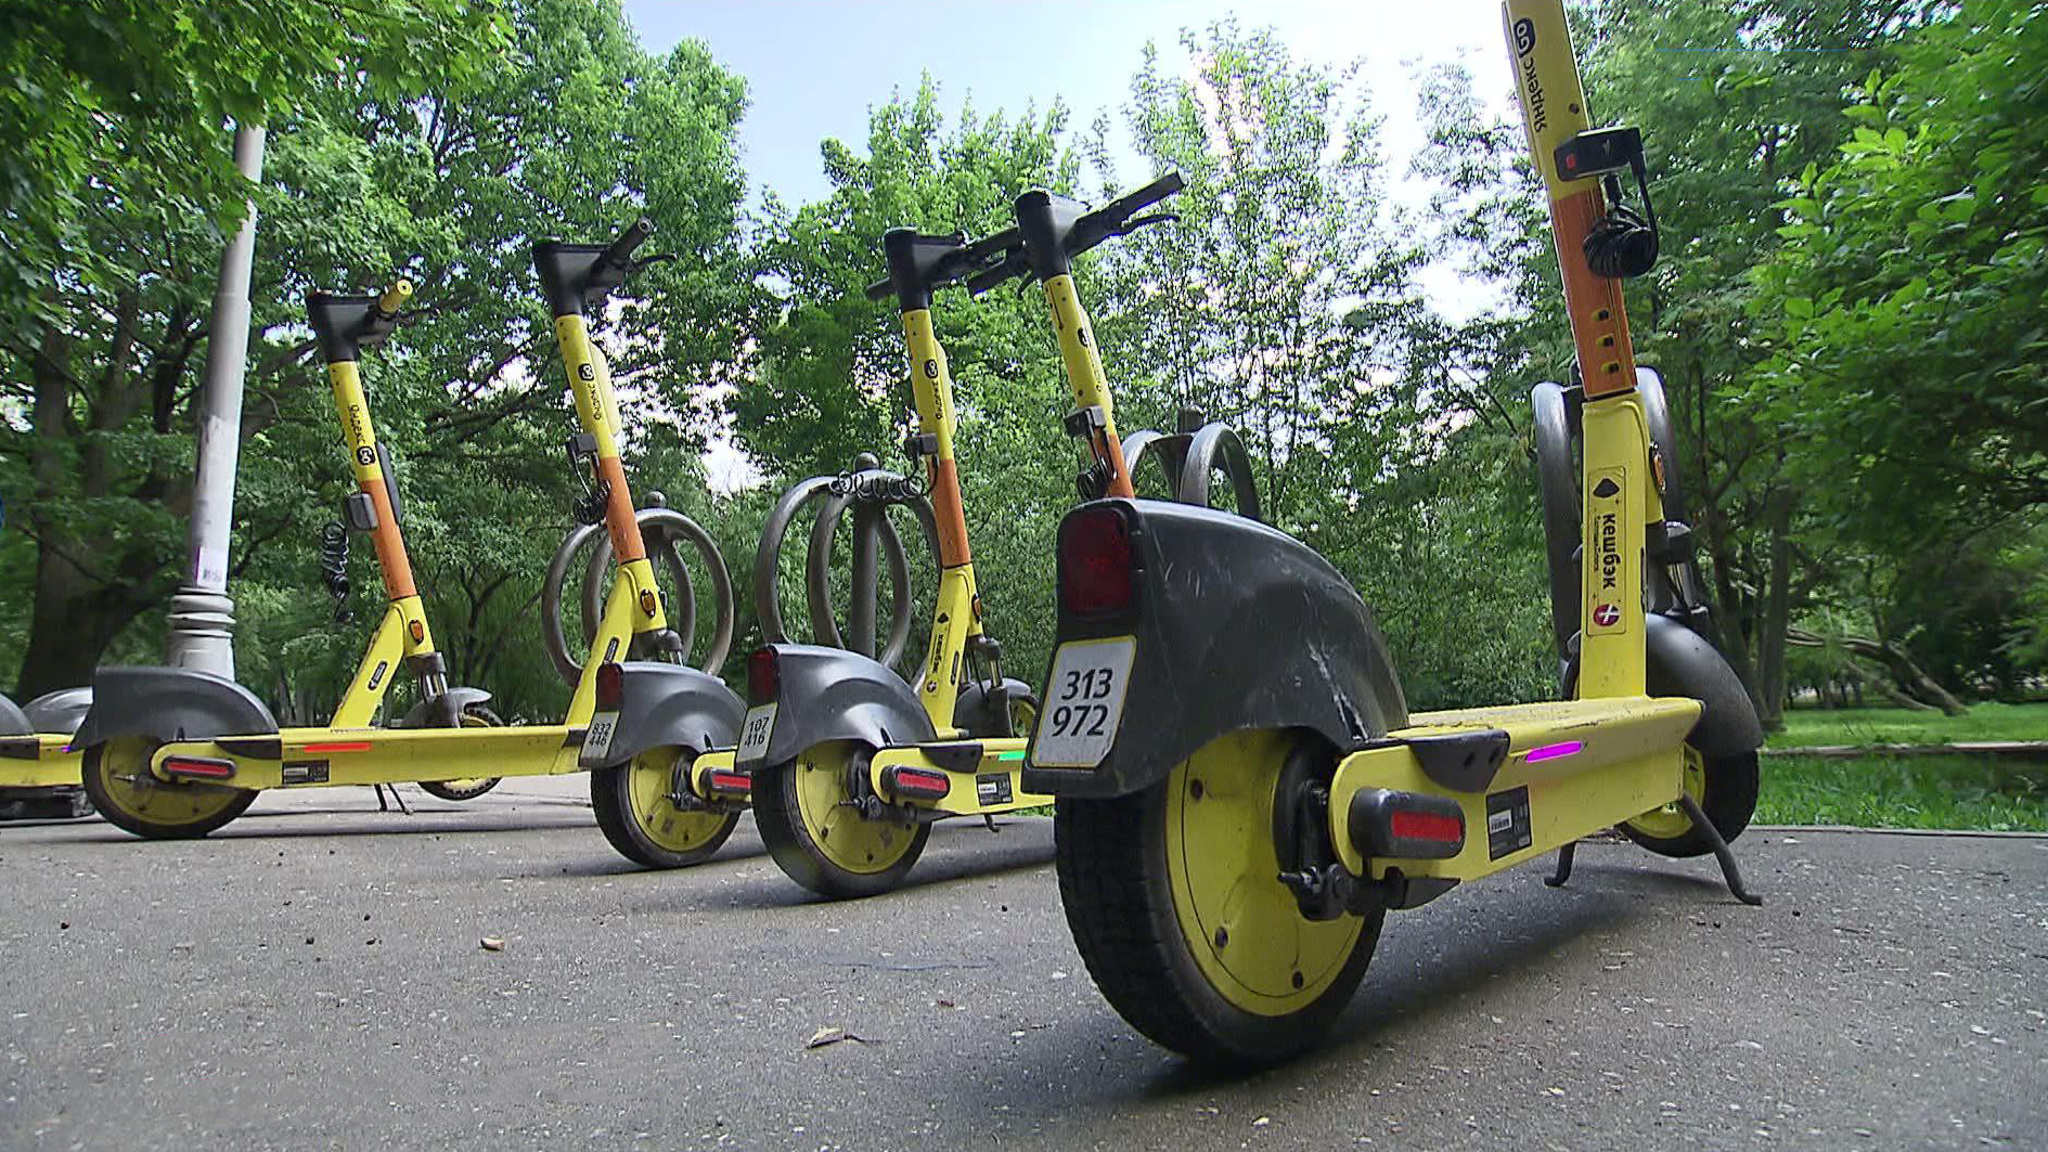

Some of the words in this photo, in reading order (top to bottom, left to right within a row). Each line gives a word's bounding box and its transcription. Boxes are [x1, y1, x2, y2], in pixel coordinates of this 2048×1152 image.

[1523, 57, 1548, 133] Яндекс
[1602, 513, 1621, 589] кешбэк
[1061, 667, 1113, 700] 313
[592, 722, 611, 736] 832
[749, 716, 769, 731] 107
[1051, 704, 1108, 737] 972
